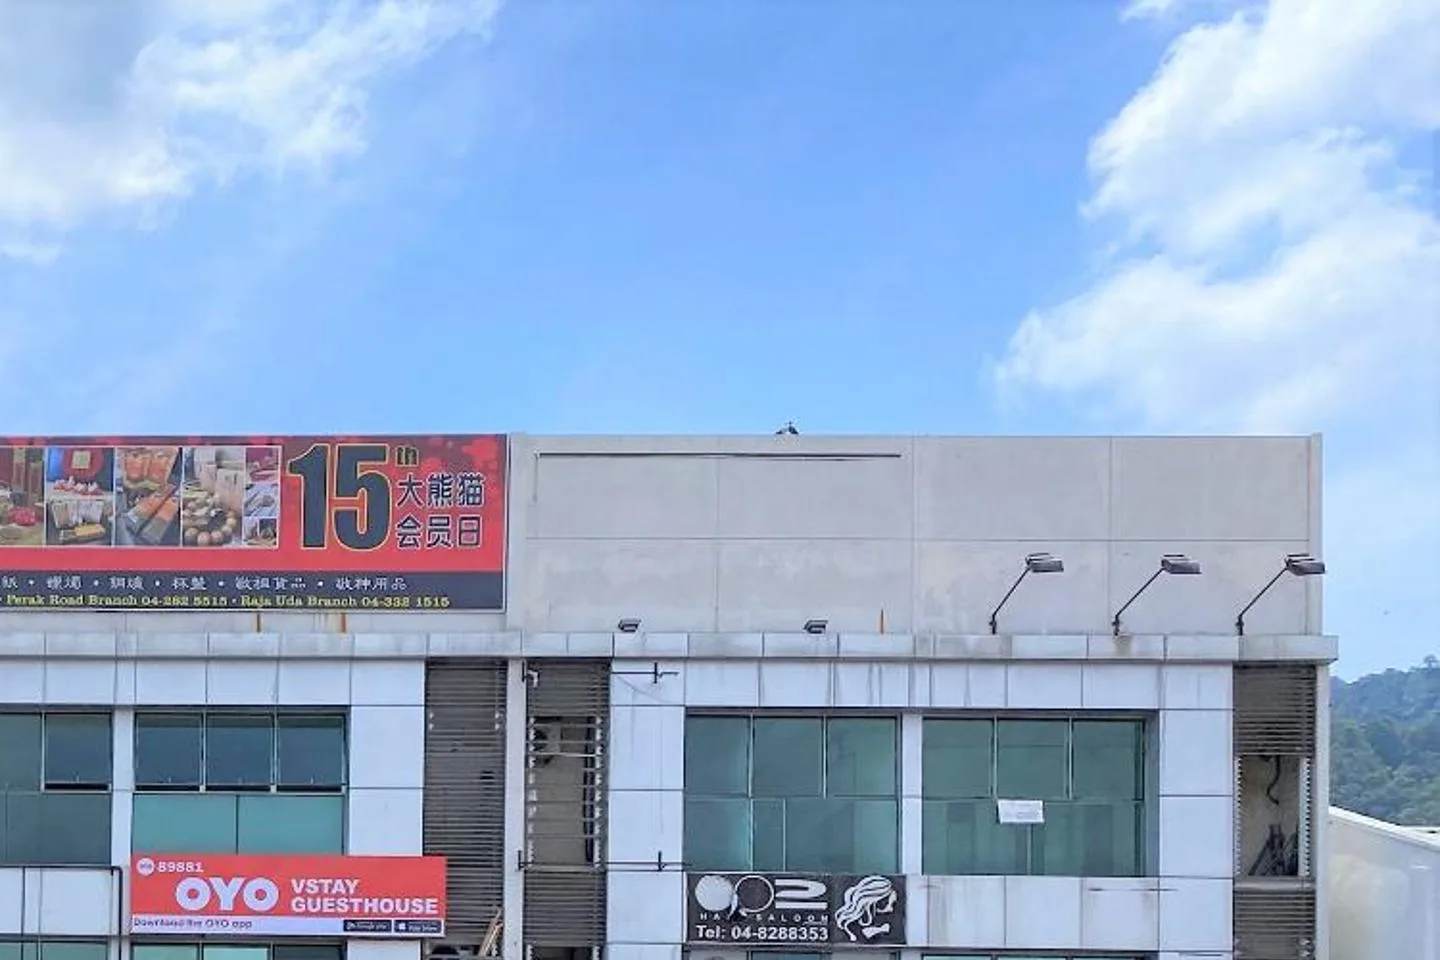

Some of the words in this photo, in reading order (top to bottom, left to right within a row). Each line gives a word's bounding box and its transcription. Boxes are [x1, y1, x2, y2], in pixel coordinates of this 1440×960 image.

[287, 443, 392, 550] 15
[396, 446, 420, 467] th
[397, 473, 486, 508] 大熊猫
[396, 514, 484, 549] 会员日
[49, 595, 85, 606] Road
[88, 595, 138, 606] Branch
[241, 595, 272, 608] Raja
[276, 595, 303, 607] Uda
[307, 596, 358, 608] Branch
[176, 876, 280, 912] OYO
[291, 879, 360, 895] VSTAY
[291, 897, 439, 915] GUESTHOUSE
[232, 919, 253, 930] app
[696, 924, 726, 939] Tel:
[731, 926, 829, 941] 04-8288353
